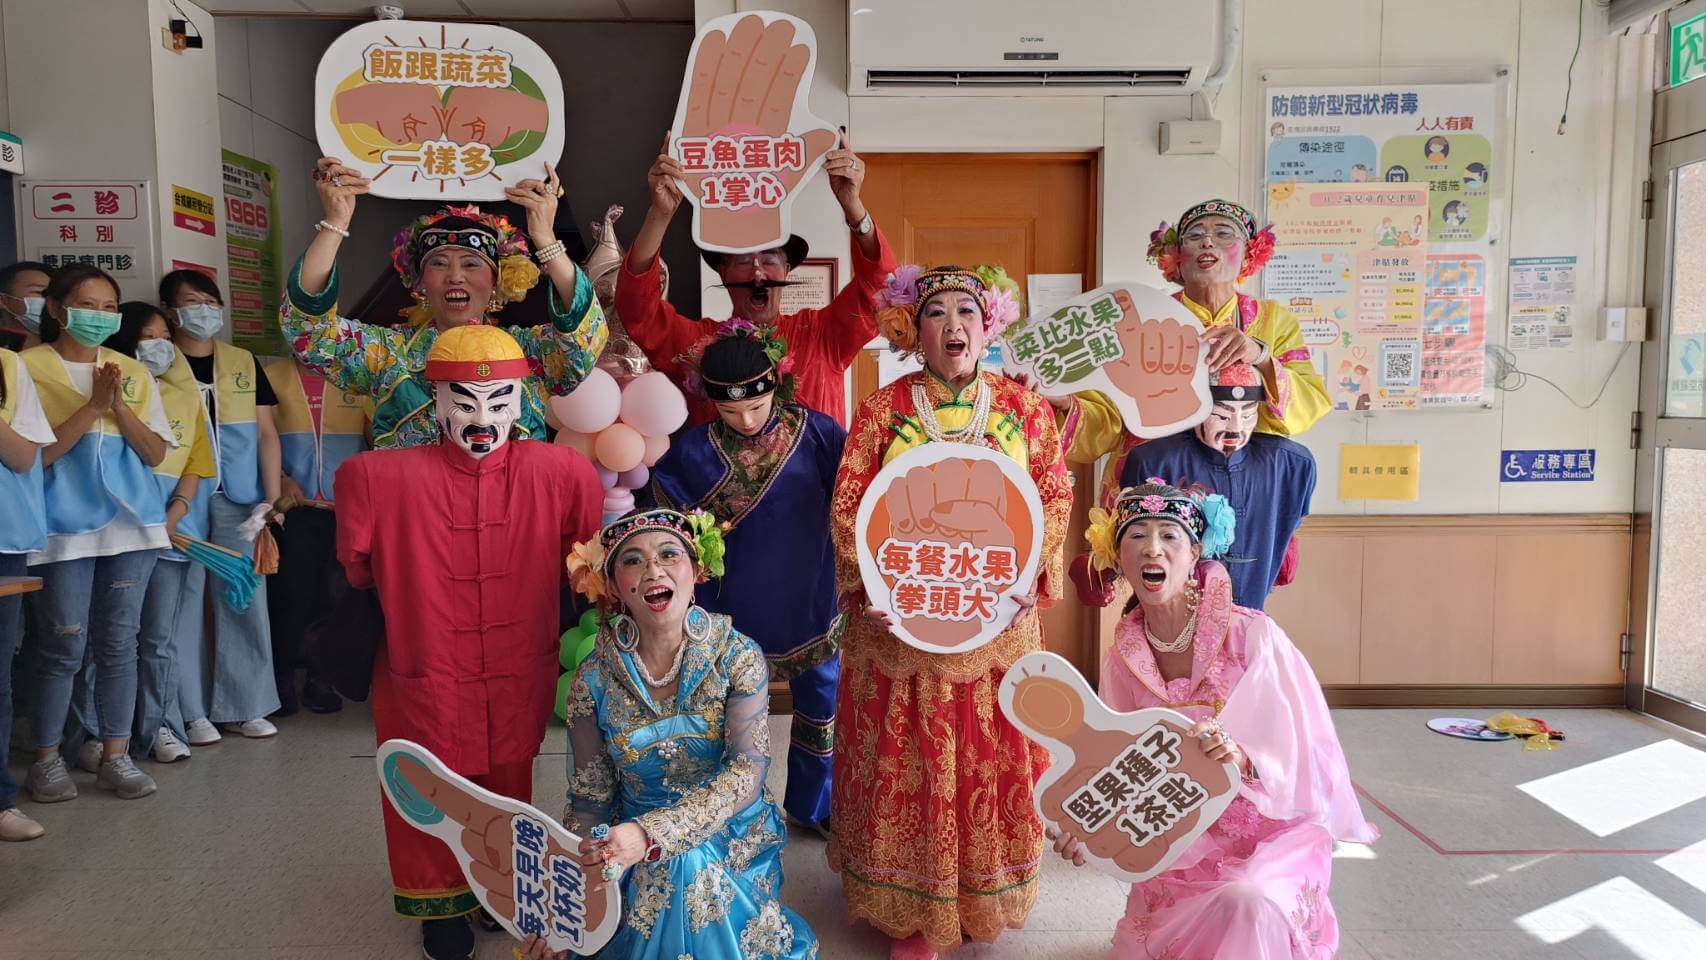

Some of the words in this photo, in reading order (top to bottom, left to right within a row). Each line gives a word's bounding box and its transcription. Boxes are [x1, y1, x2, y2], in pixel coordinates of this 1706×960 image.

[369, 48, 507, 84] 飯跟蔬菜
[1272, 93, 1418, 117] 防範新型冠狀病毒
[1416, 116, 1474, 131] 人人有責
[387, 145, 490, 176] 一樣多
[680, 138, 800, 170] 豆魚蛋肉
[51, 190, 119, 215] 二診
[703, 176, 783, 206] 1掌心
[224, 196, 268, 229] 1966
[59, 225, 115, 242] 科別
[1013, 297, 1121, 361] 菜比水果
[1038, 332, 1121, 384] 多一點
[1531, 470, 1560, 479] Service
[1562, 470, 1591, 479] Station
[1532, 453, 1592, 470] 服務專區
[881, 543, 1013, 581] 每餐水果
[896, 583, 994, 618] 拳頭大
[1067, 730, 1178, 829] 堅果種子
[1121, 777, 1204, 842] 1茶匙
[515, 818, 545, 938] 每天早晚
[552, 859, 584, 943] 1杯奶
